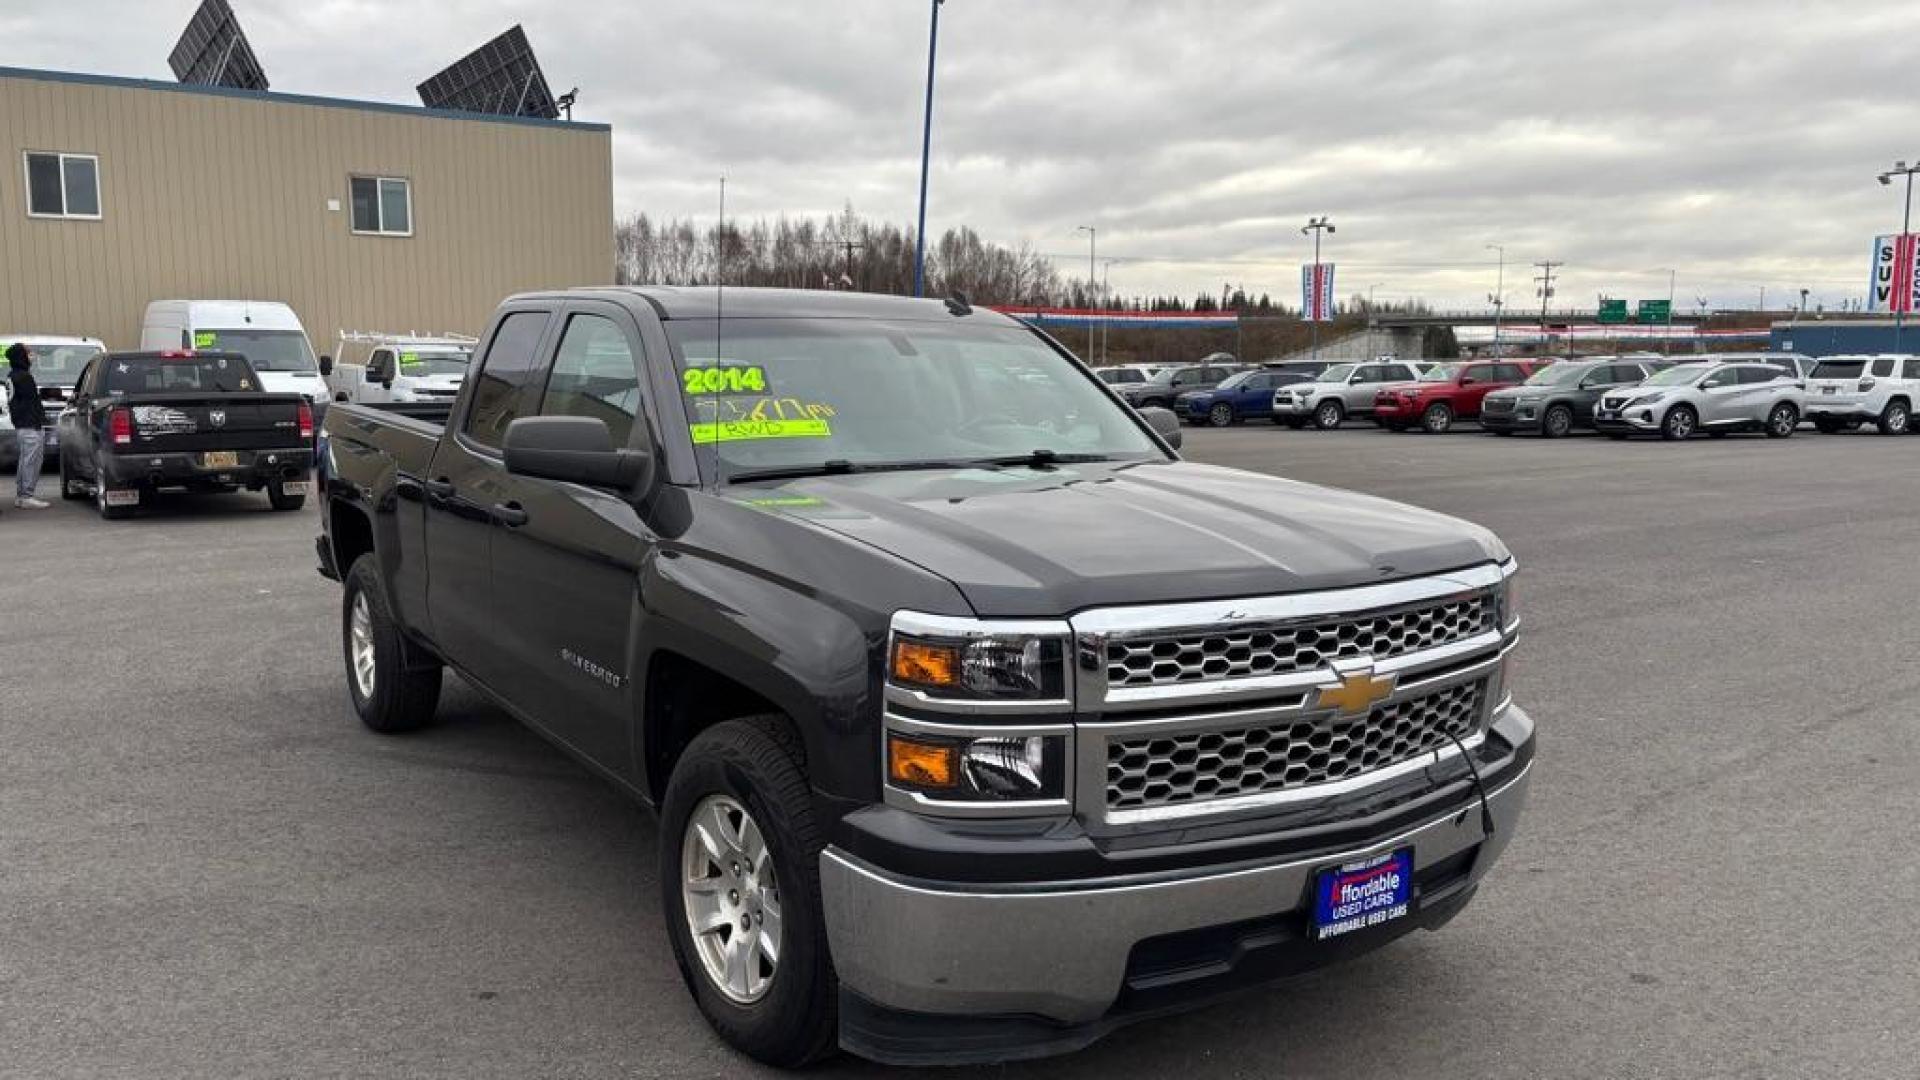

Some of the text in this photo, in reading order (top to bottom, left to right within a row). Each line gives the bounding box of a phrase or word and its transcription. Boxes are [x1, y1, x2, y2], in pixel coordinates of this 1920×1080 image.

[1877, 247, 1893, 301] SUV
[683, 367, 765, 393] 2014
[1331, 871, 1399, 906] Affordable
[1332, 892, 1394, 920] USED CARS
[1388, 904, 1408, 919] CARS
